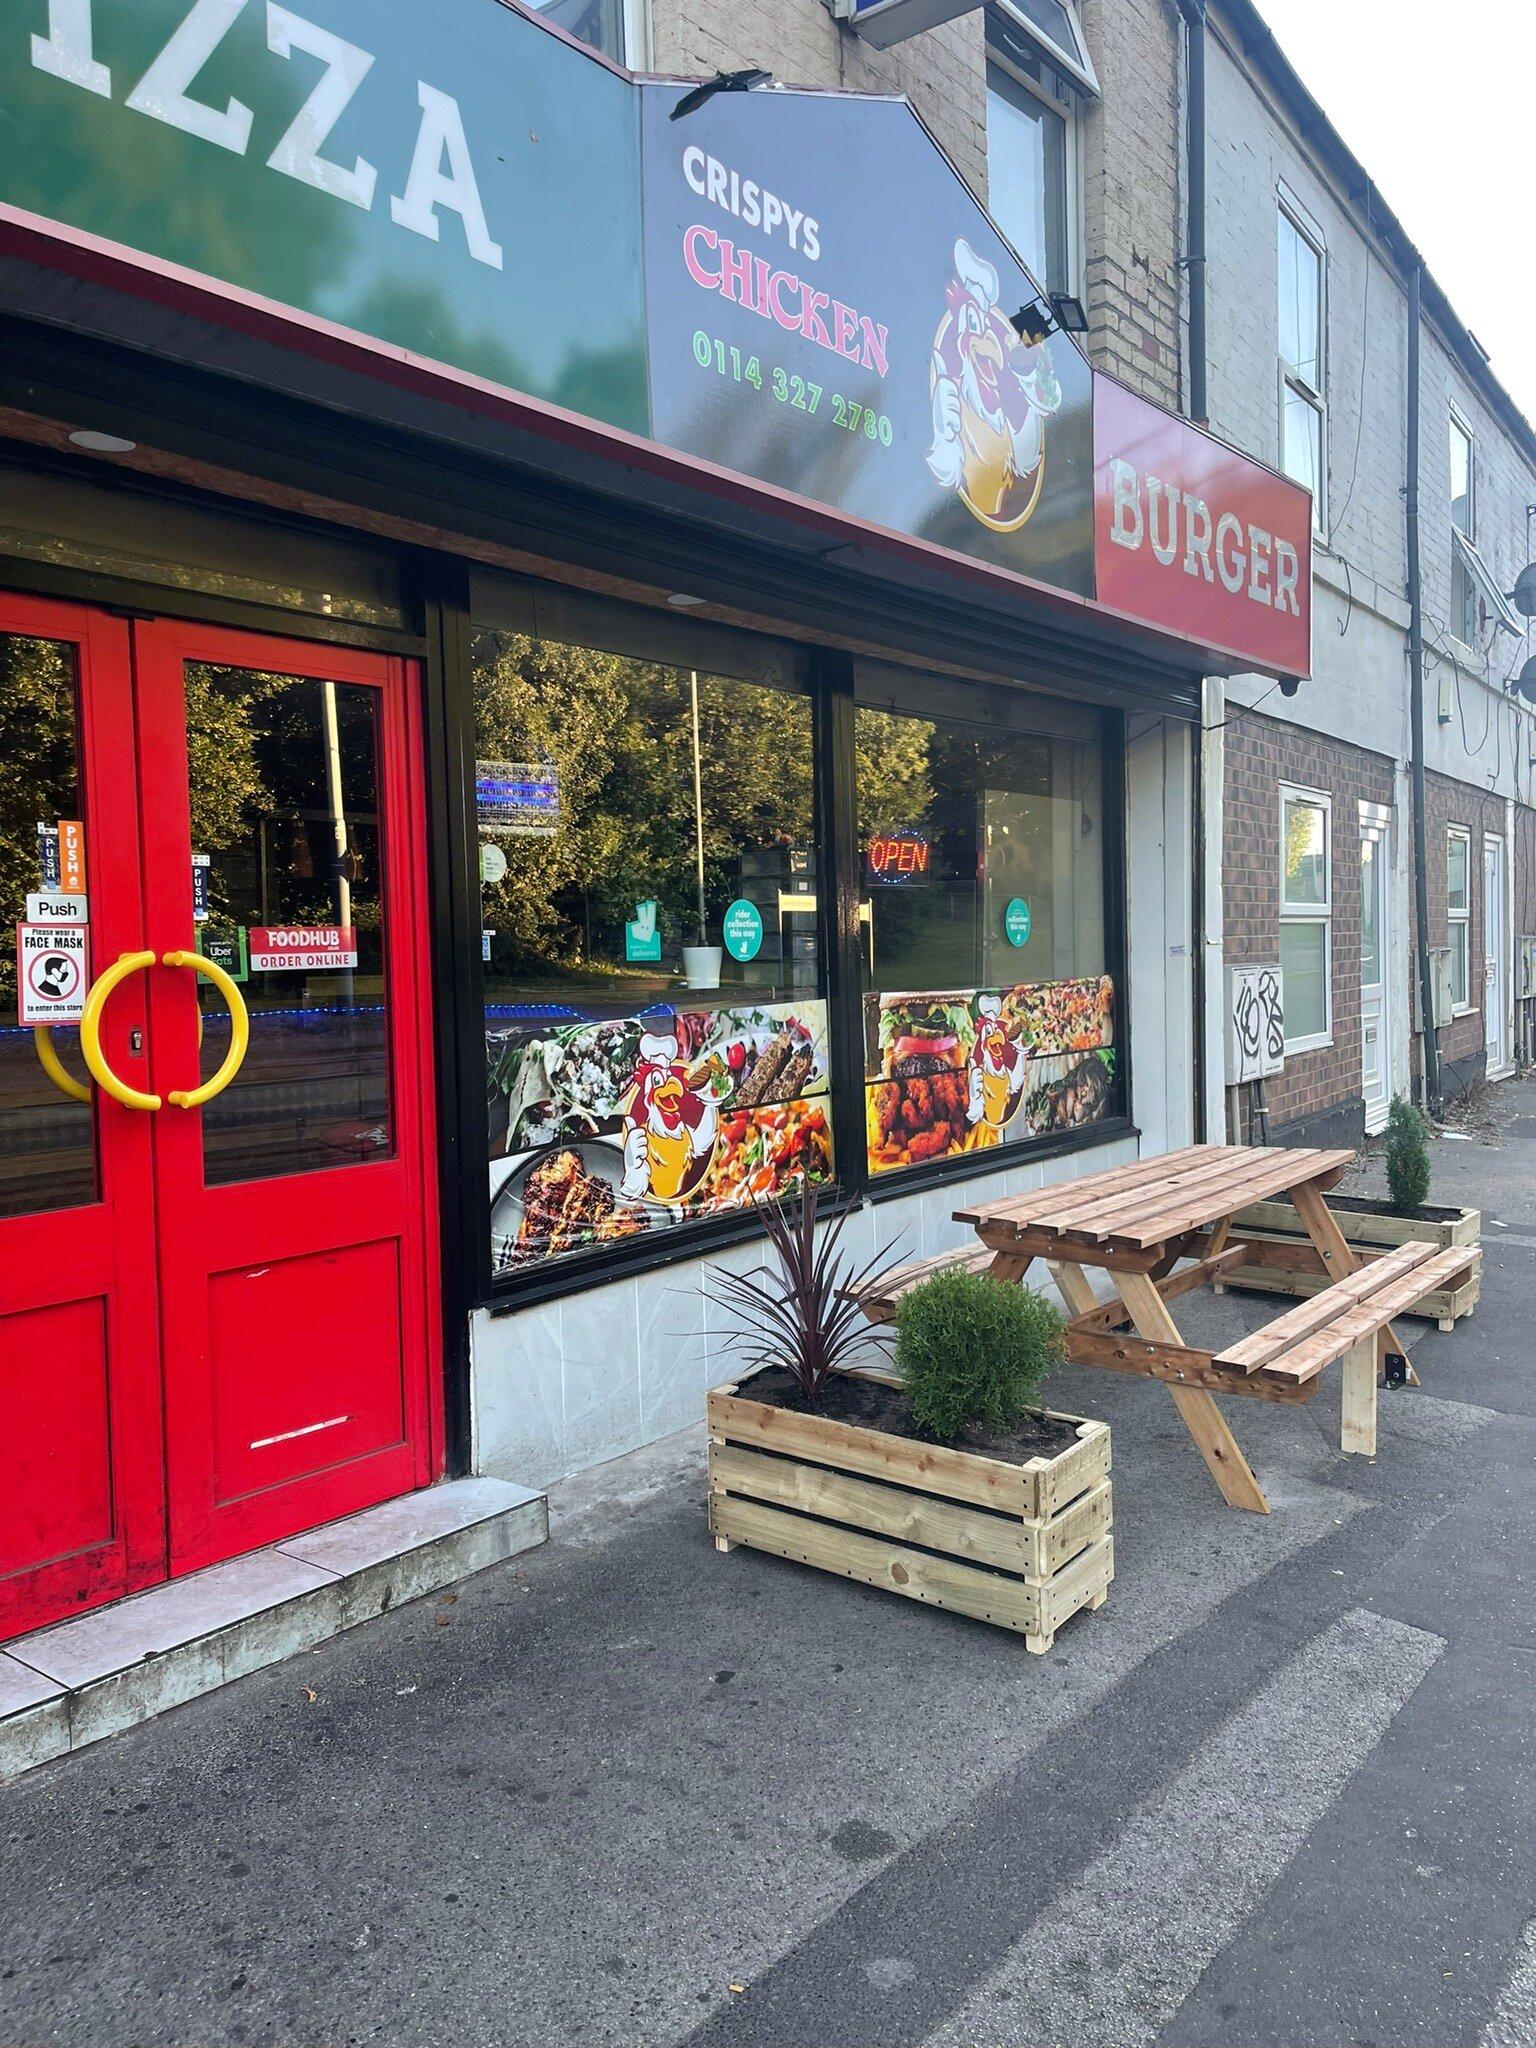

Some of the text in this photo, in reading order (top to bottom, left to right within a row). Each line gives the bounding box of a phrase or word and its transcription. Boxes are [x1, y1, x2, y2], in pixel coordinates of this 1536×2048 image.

[682, 145, 821, 261] CRISPYS
[683, 224, 889, 378] CHICKEN
[693, 329, 893, 447] 0114 327 2780
[1110, 456, 1301, 617] BURGER
[66, 825, 79, 873] PUSH
[870, 841, 928, 872] OPEN
[45, 838, 55, 878] PUSH
[194, 869, 203, 906] PUSH
[39, 902, 77, 916] Push
[735, 909, 751, 919] rider
[727, 919, 759, 928] collection
[32, 928, 53, 936] Please
[267, 930, 340, 947] FOODHUB
[730, 929, 755, 940] this way
[25, 937, 83, 949] FACE MASK
[210, 946, 232, 956] Uber
[260, 954, 349, 968] ORDER ONLINE
[35, 1004, 52, 1012] enter
